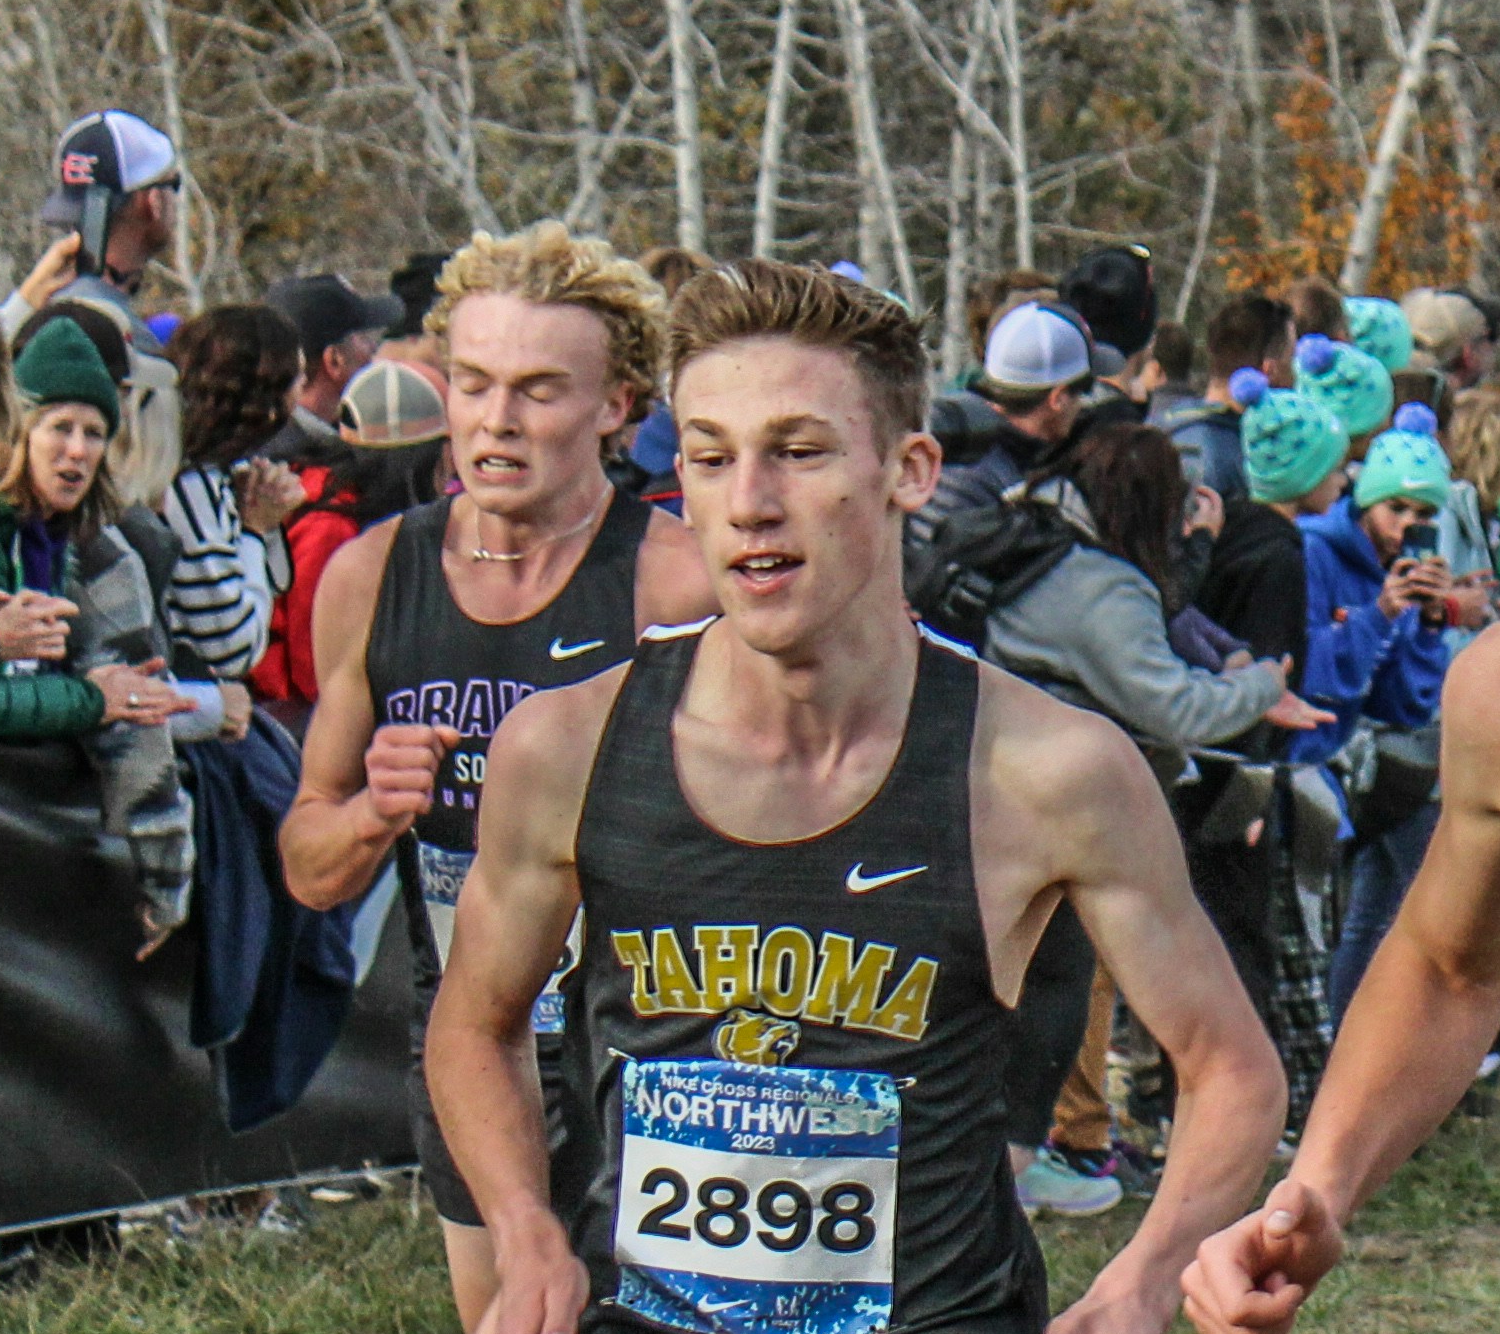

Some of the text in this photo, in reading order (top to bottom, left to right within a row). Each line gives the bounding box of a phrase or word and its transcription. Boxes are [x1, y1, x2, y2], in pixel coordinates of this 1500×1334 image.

[610, 924, 941, 1041] TAHOMA
[635, 1086, 888, 1136] NORTHWEST
[661, 1074, 856, 1105] NIKE CROSS REGIONALS
[731, 1133, 777, 1152] 2023
[637, 1167, 877, 1253] 2898
